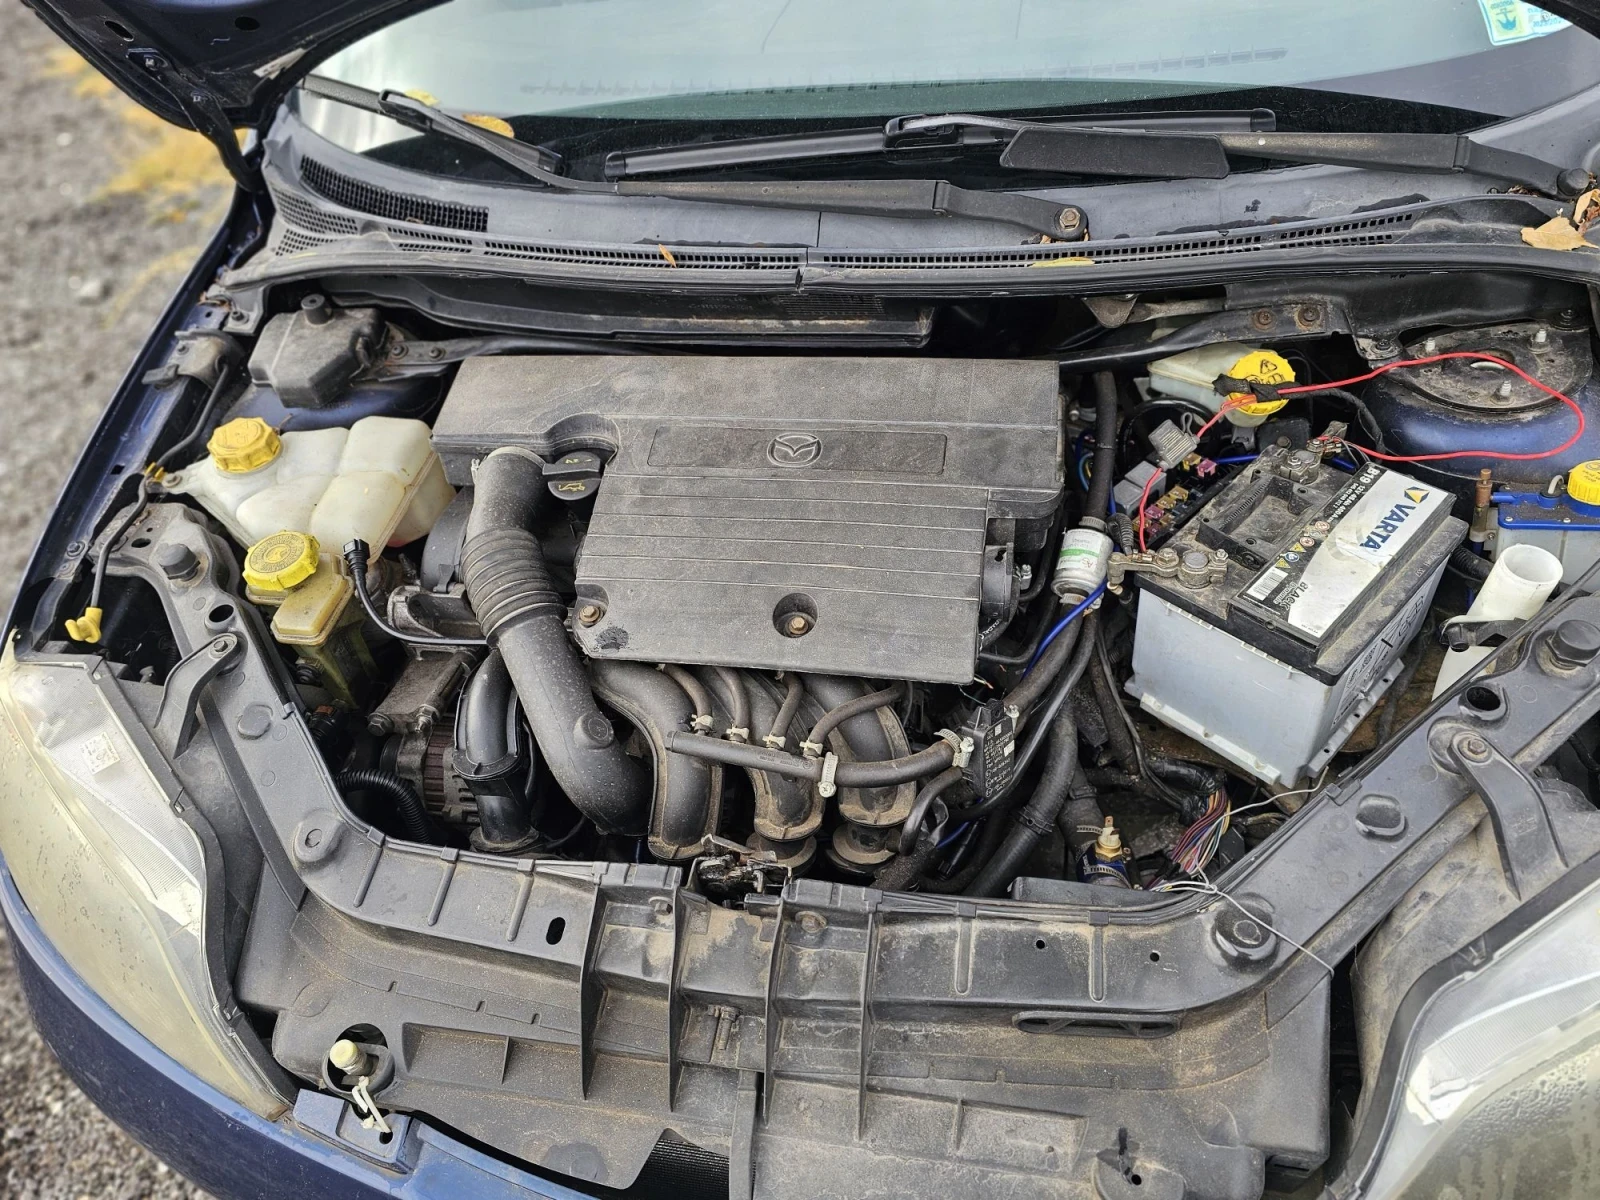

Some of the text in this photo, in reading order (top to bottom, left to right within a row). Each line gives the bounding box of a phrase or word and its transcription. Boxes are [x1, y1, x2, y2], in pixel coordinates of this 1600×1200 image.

[1360, 467, 1380, 483] B19
[1355, 485, 1365, 495] 12V
[1359, 504, 1416, 549] VARTA
[1279, 581, 1308, 610] BLACK
